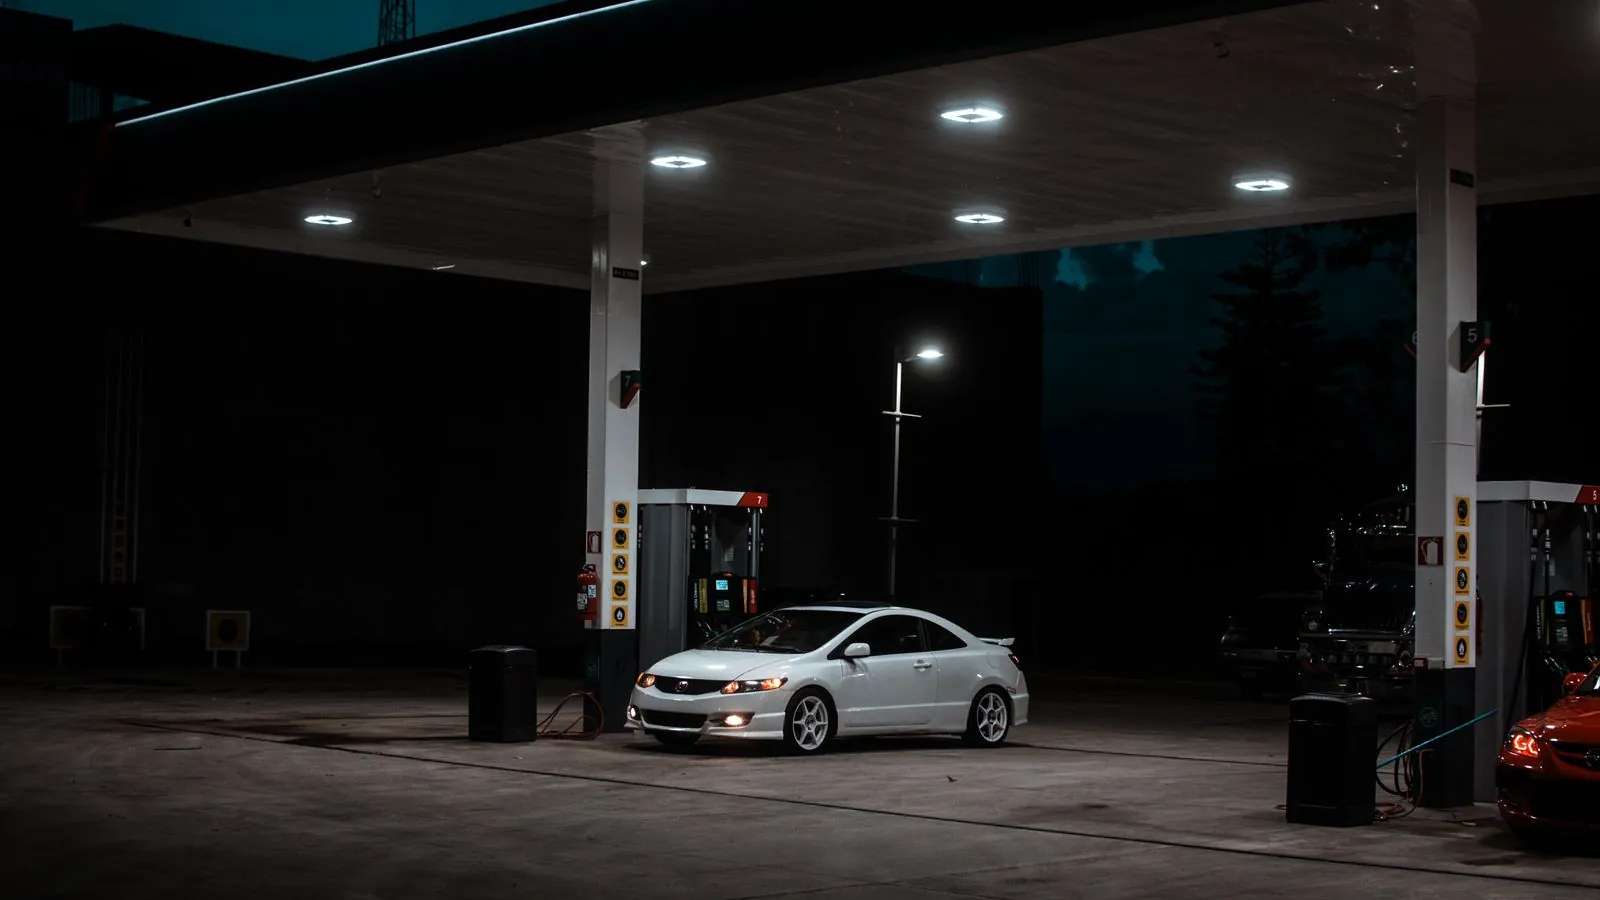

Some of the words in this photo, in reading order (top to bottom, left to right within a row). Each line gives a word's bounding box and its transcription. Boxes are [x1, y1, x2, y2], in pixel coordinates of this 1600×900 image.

[1467, 328, 1477, 343] 5
[625, 375, 631, 388] 7
[757, 495, 762, 505] 7
[1592, 490, 1597, 501] 5
